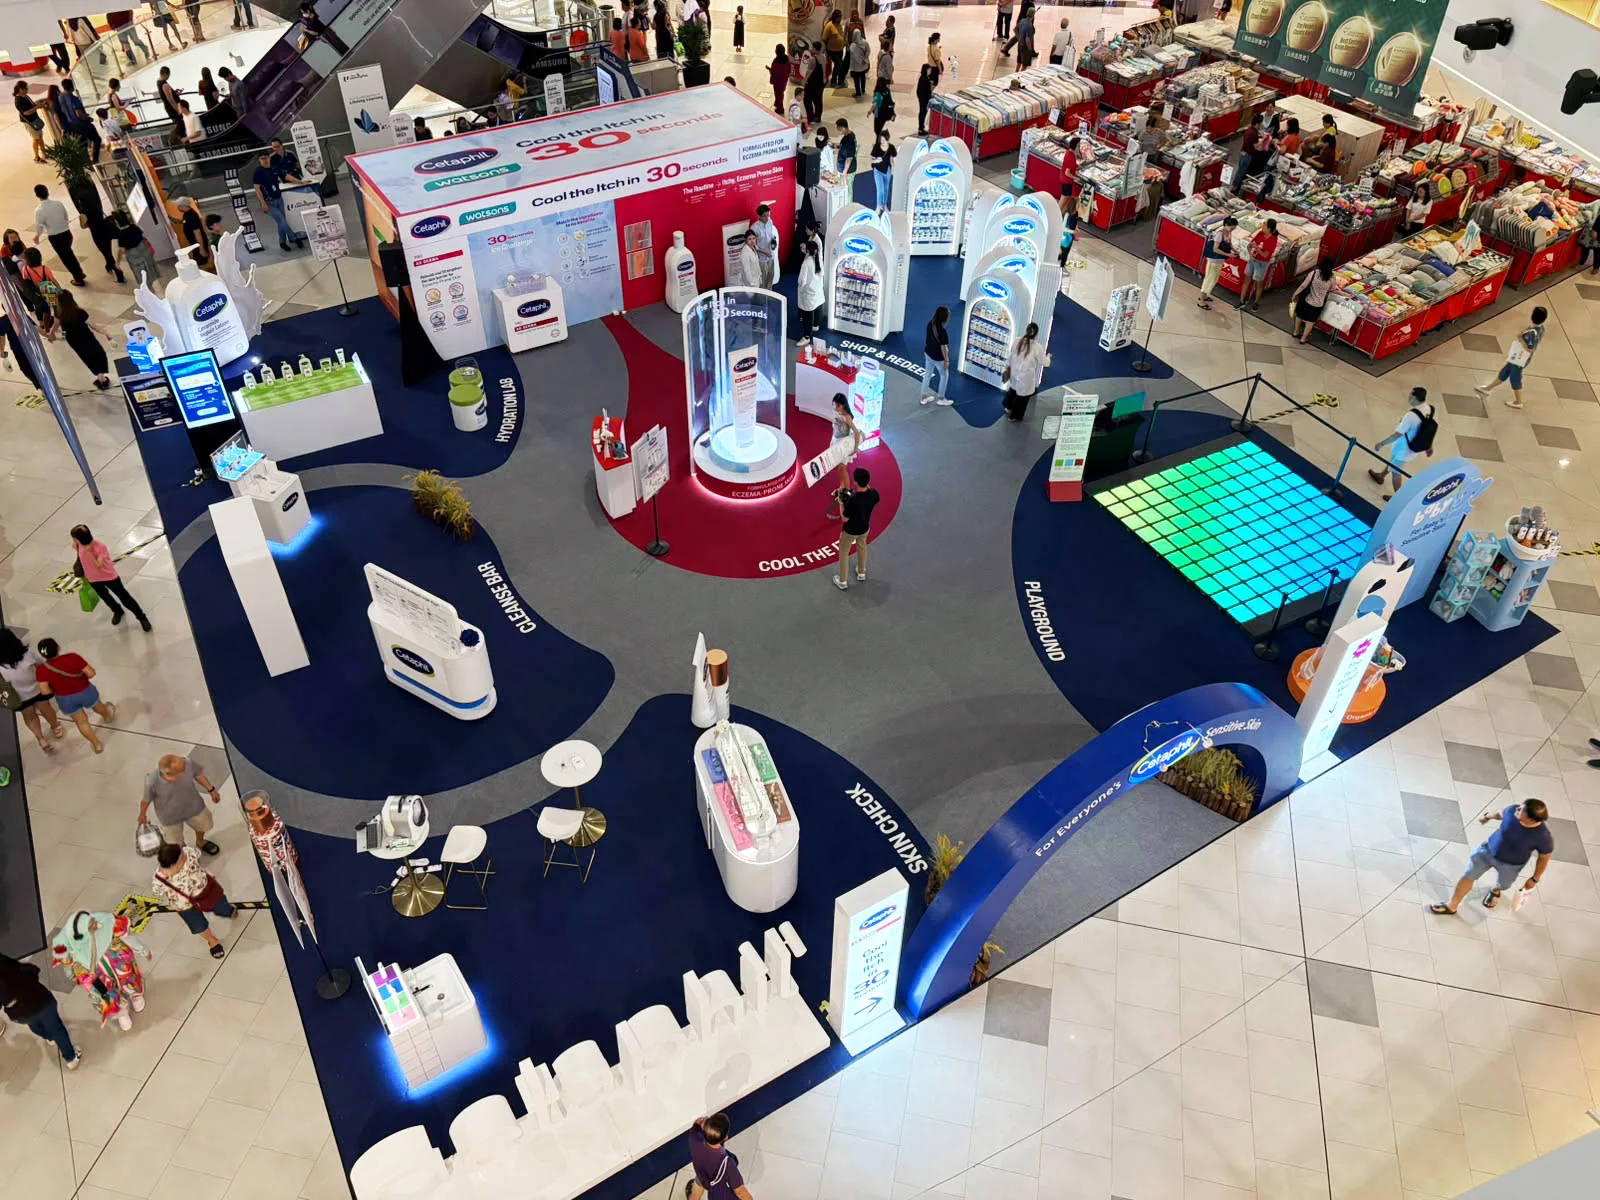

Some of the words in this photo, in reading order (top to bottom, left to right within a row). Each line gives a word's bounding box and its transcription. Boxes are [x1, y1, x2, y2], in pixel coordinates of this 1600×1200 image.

[516, 132, 566, 148] Cool
[568, 125, 602, 139] the
[604, 116, 645, 131] Itch
[647, 112, 667, 122] in
[525, 130, 632, 162] 30
[636, 111, 724, 136] seconds
[742, 140, 775, 153] FORMULATED
[774, 138, 784, 146] FOR
[742, 151, 762, 161] ECZEMA
[420, 150, 493, 171] Cetaphil
[435, 166, 510, 188] watsons
[532, 192, 567, 208] Cool
[569, 186, 594, 198] the
[596, 178, 626, 193] Itch
[628, 175, 641, 186] in
[647, 162, 682, 184] 30
[682, 156, 728, 173] seconds
[683, 186, 693, 196] The
[694, 182, 714, 193] Routine
[736, 174, 757, 182] Eczema
[772, 166, 784, 174] Skin
[465, 204, 510, 222] watsons
[413, 219, 448, 235] Cetaphil
[487, 234, 508, 246] 30
[195, 297, 225, 318] Cetaphil
[520, 302, 548, 315] Cetaphil
[727, 297, 736, 305] in
[731, 309, 768, 320] Seconds
[840, 340, 877, 357] SHOP
[876, 351, 886, 360] &
[499, 378, 516, 394] LAB
[495, 393, 518, 442] HYDRATION
[1426, 479, 1461, 500] Cetaphil
[1412, 498, 1454, 526] baby
[758, 556, 806, 572] COOL
[802, 545, 836, 564] THE
[478, 561, 504, 586] BAR
[490, 582, 537, 634] CLEANSE
[1024, 580, 1066, 662] PLAYGROUND
[394, 648, 431, 674] Cetaphil
[1206, 720, 1246, 739] Sensitive
[1244, 718, 1262, 731] Skin
[1137, 736, 1198, 775] Cetaphil
[845, 782, 899, 836] CHECK
[1034, 836, 1056, 857] For
[1056, 780, 1122, 836] Everyone's
[889, 830, 929, 874] SKIN
[862, 940, 888, 958] Cool
[866, 951, 884, 964] the
[854, 969, 890, 996] 30
